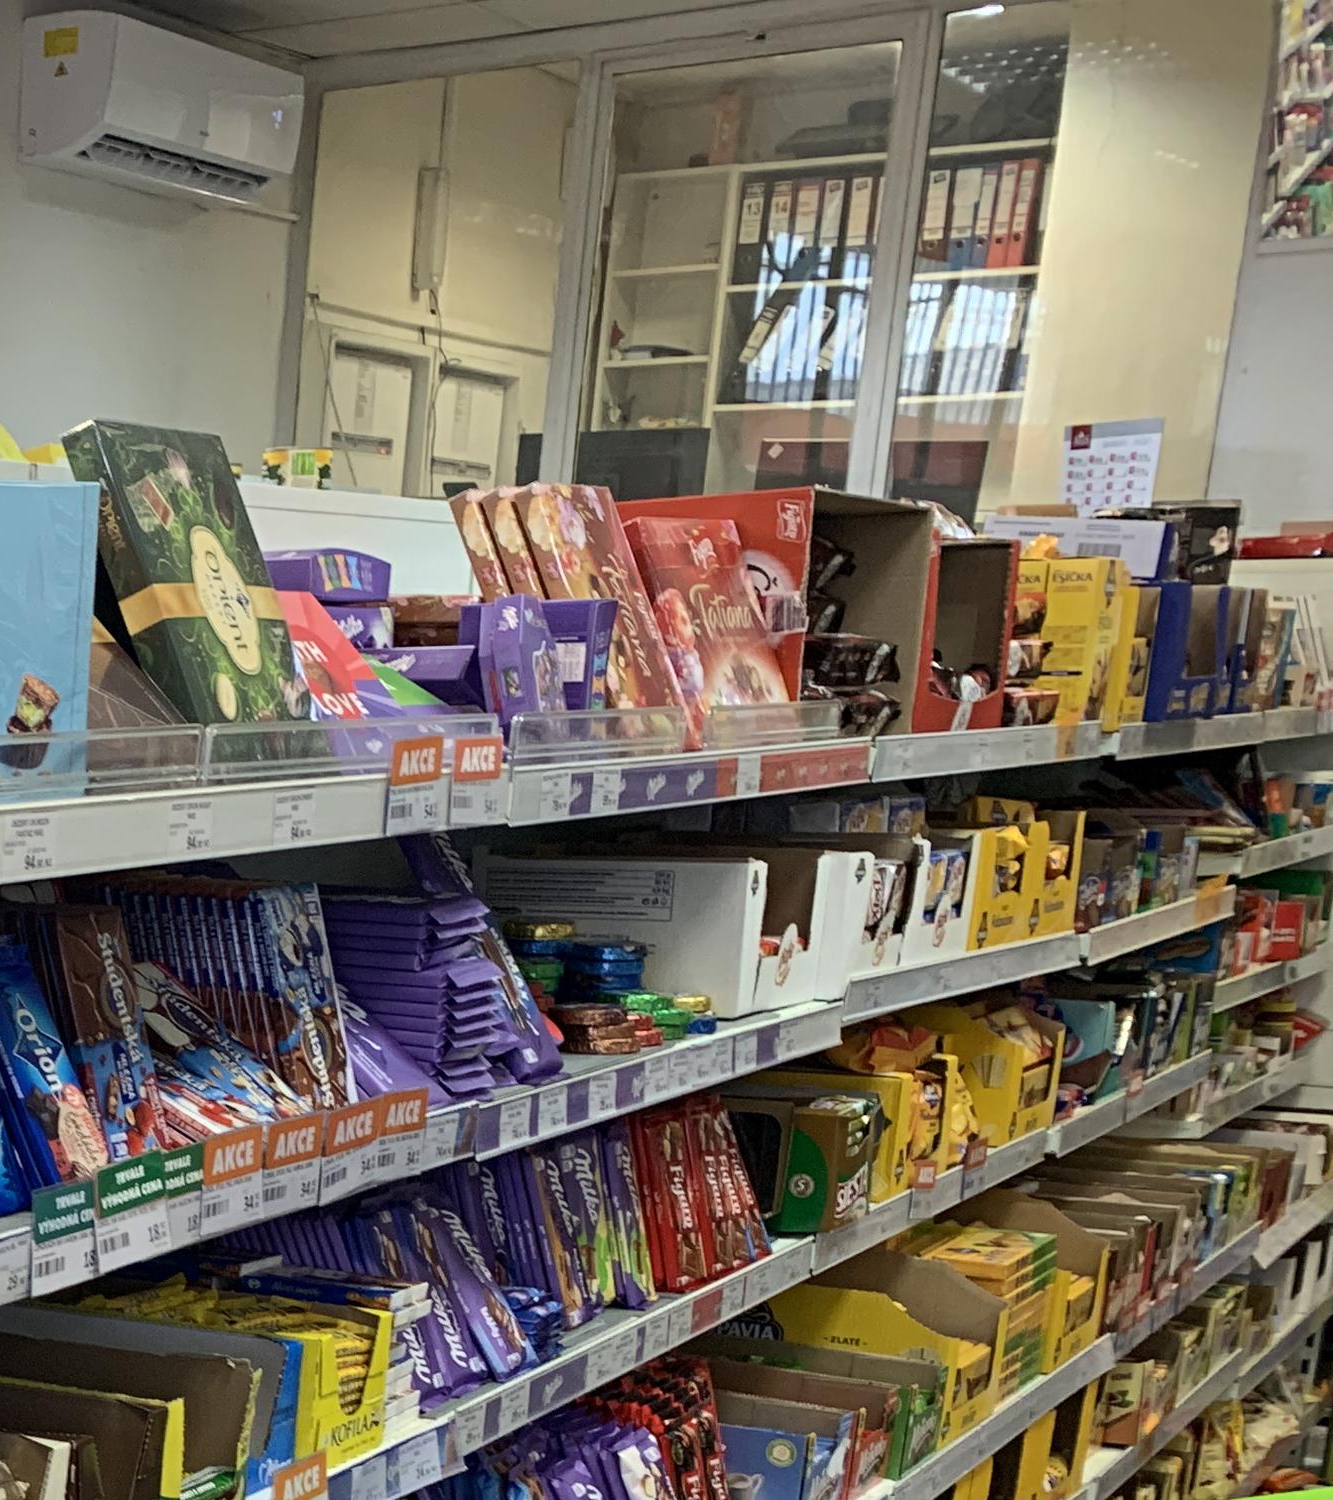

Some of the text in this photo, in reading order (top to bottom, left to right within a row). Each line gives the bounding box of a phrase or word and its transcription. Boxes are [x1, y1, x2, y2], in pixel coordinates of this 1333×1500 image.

[319, 692, 369, 715] LOVE
[399, 748, 436, 776] AKCE
[460, 747, 496, 773] AKCE
[332, 1109, 375, 1144] AKCE
[383, 1098, 423, 1131] AKCE
[212, 1141, 254, 1174] AKCE
[273, 1128, 316, 1159] AKCE
